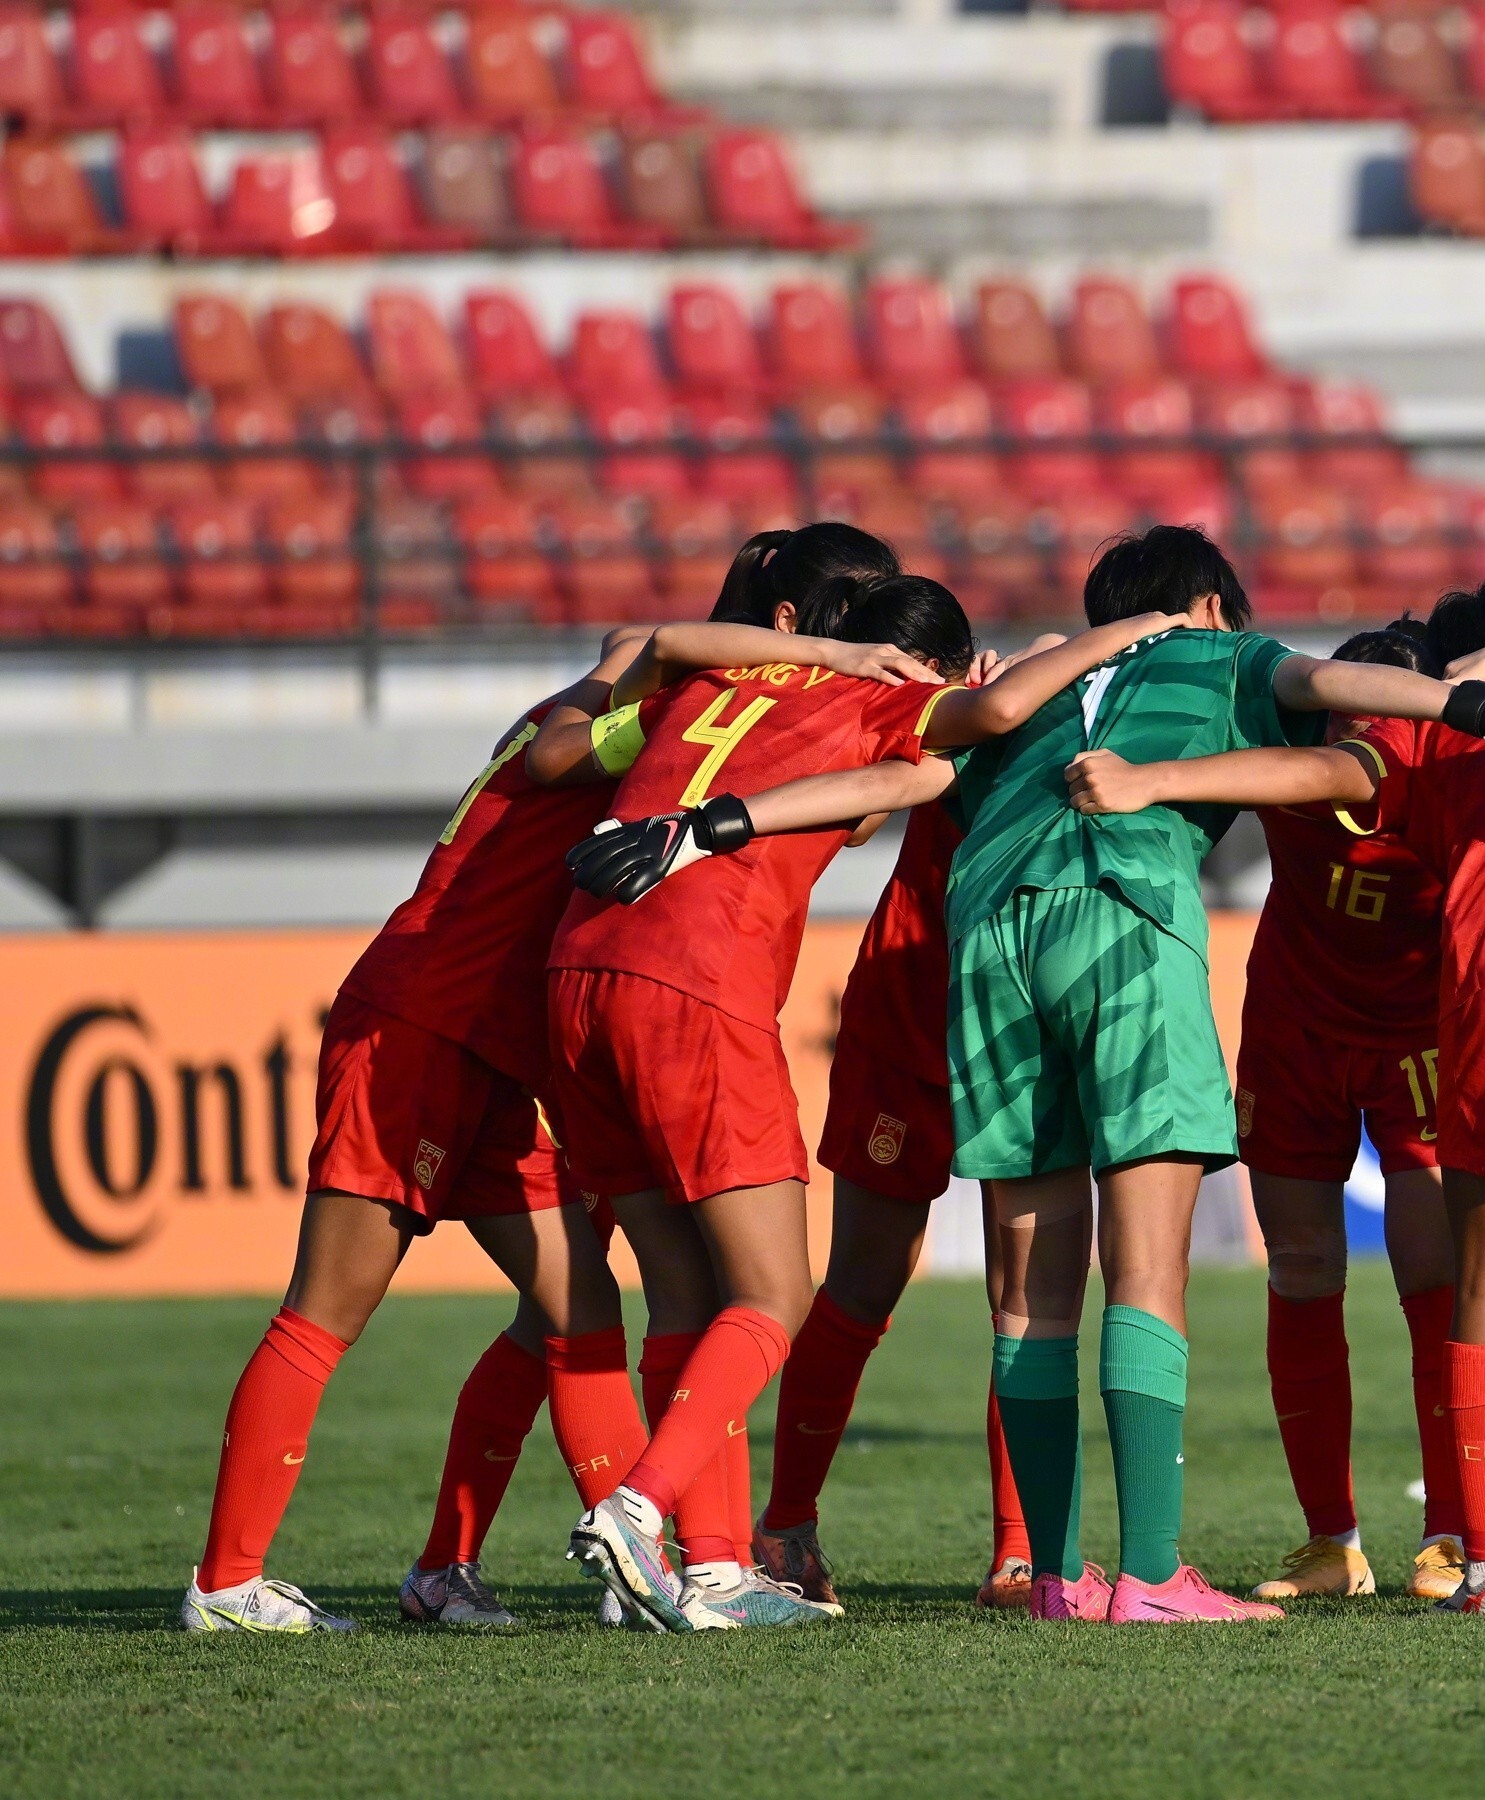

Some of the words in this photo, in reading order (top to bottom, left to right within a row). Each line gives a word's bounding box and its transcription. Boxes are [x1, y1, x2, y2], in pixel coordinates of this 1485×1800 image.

[677, 686, 779, 809] 4
[1326, 861, 1391, 922] 16
[26, 998, 333, 1262] Cont
[418, 1142, 443, 1162] CFA
[572, 1454, 611, 1479] FA
